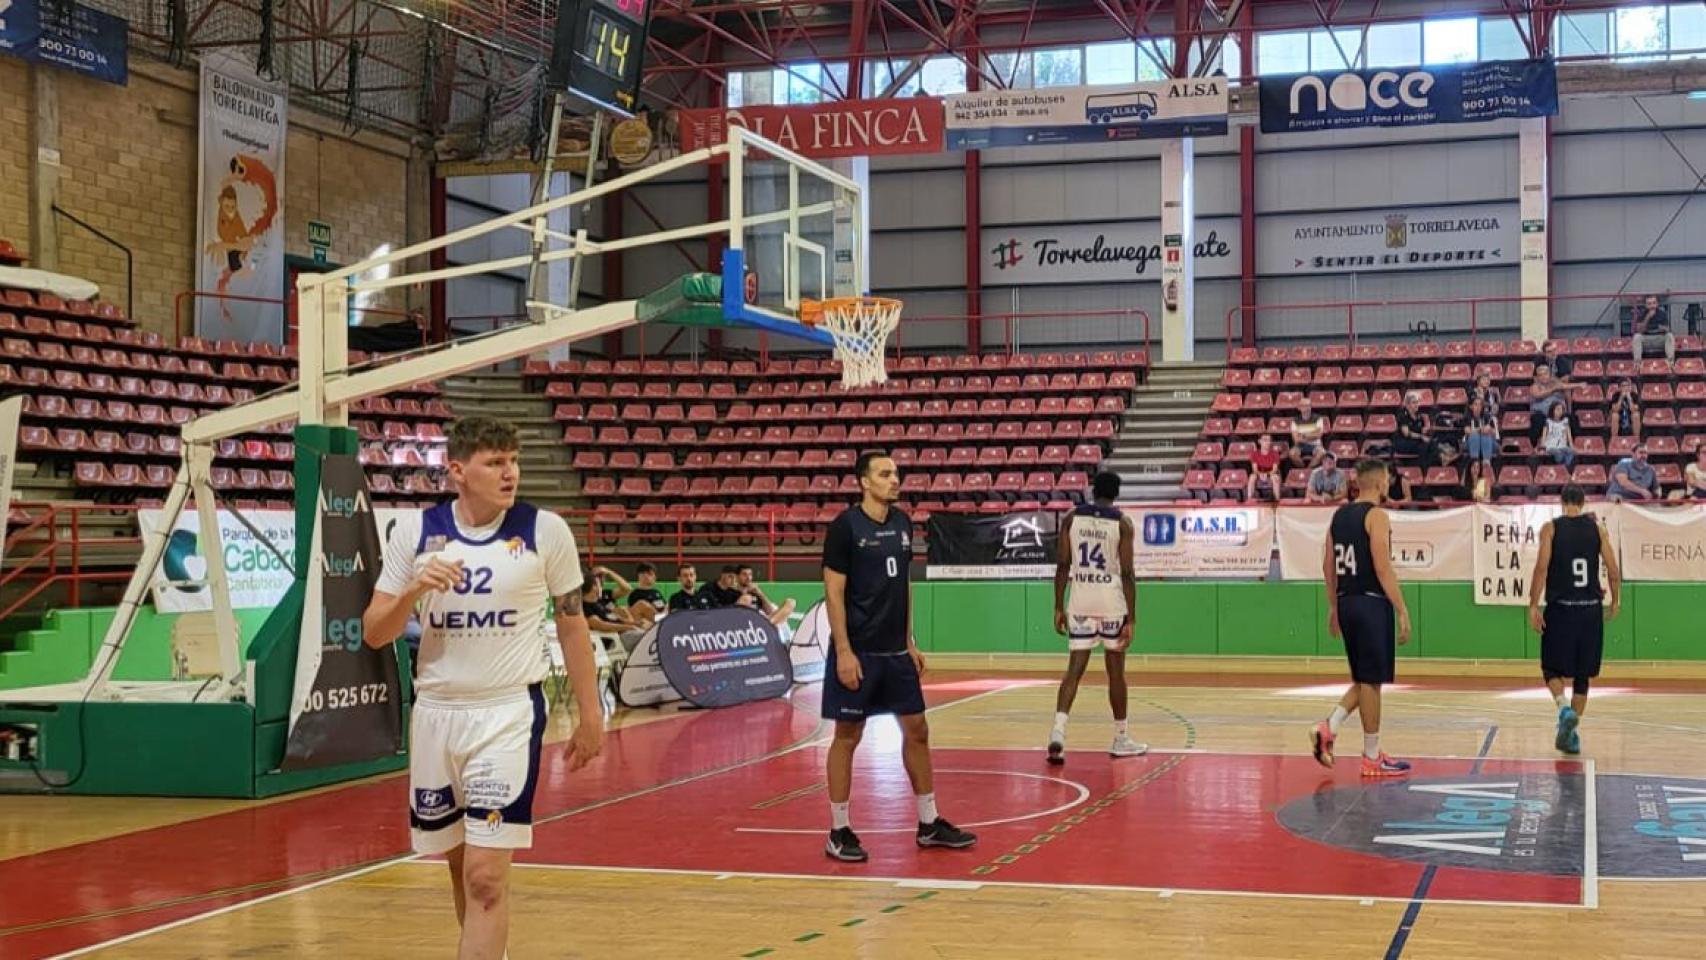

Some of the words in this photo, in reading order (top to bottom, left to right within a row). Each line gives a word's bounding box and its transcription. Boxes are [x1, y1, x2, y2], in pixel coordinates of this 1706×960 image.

[78, 49, 95, 61] 00
[595, 23, 631, 77] 14
[1168, 82, 1220, 98] ALSA
[1289, 71, 1435, 114] nace
[213, 90, 280, 126] TORRELAVEGA
[954, 98, 992, 110] Alquiler
[996, 96, 1009, 107] de
[1011, 94, 1066, 106] autobuses
[1112, 107, 1138, 116] ALSA
[753, 113, 800, 149] LA
[812, 107, 928, 149] FINCA
[1294, 223, 1384, 239] AYUNTAMIENTO
[1409, 217, 1500, 234] TORRELAVEGA
[1034, 234, 1162, 274] Torrelavega
[1193, 230, 1231, 257] ate
[1384, 253, 1400, 264] EL
[1409, 250, 1486, 264] DEPORTE
[223, 527, 256, 542] Parqu
[1483, 521, 1535, 544] PEÑA
[224, 543, 296, 572] Cabár
[1079, 541, 1106, 570] 14
[1334, 544, 1357, 575] 24
[1392, 549, 1425, 561] LA
[1496, 551, 1520, 570] LA
[1641, 543, 1706, 561] FERNÁ
[886, 556, 898, 578] 0
[1571, 558, 1588, 588] 9
[1075, 573, 1112, 584] IVECO
[1482, 576, 1524, 598] CAN
[321, 605, 362, 652] leg
[429, 609, 518, 629] UEMC
[672, 620, 768, 653] mimoondo
[303, 691, 324, 713] 00
[329, 687, 358, 709] 525
[361, 683, 388, 704] 672
